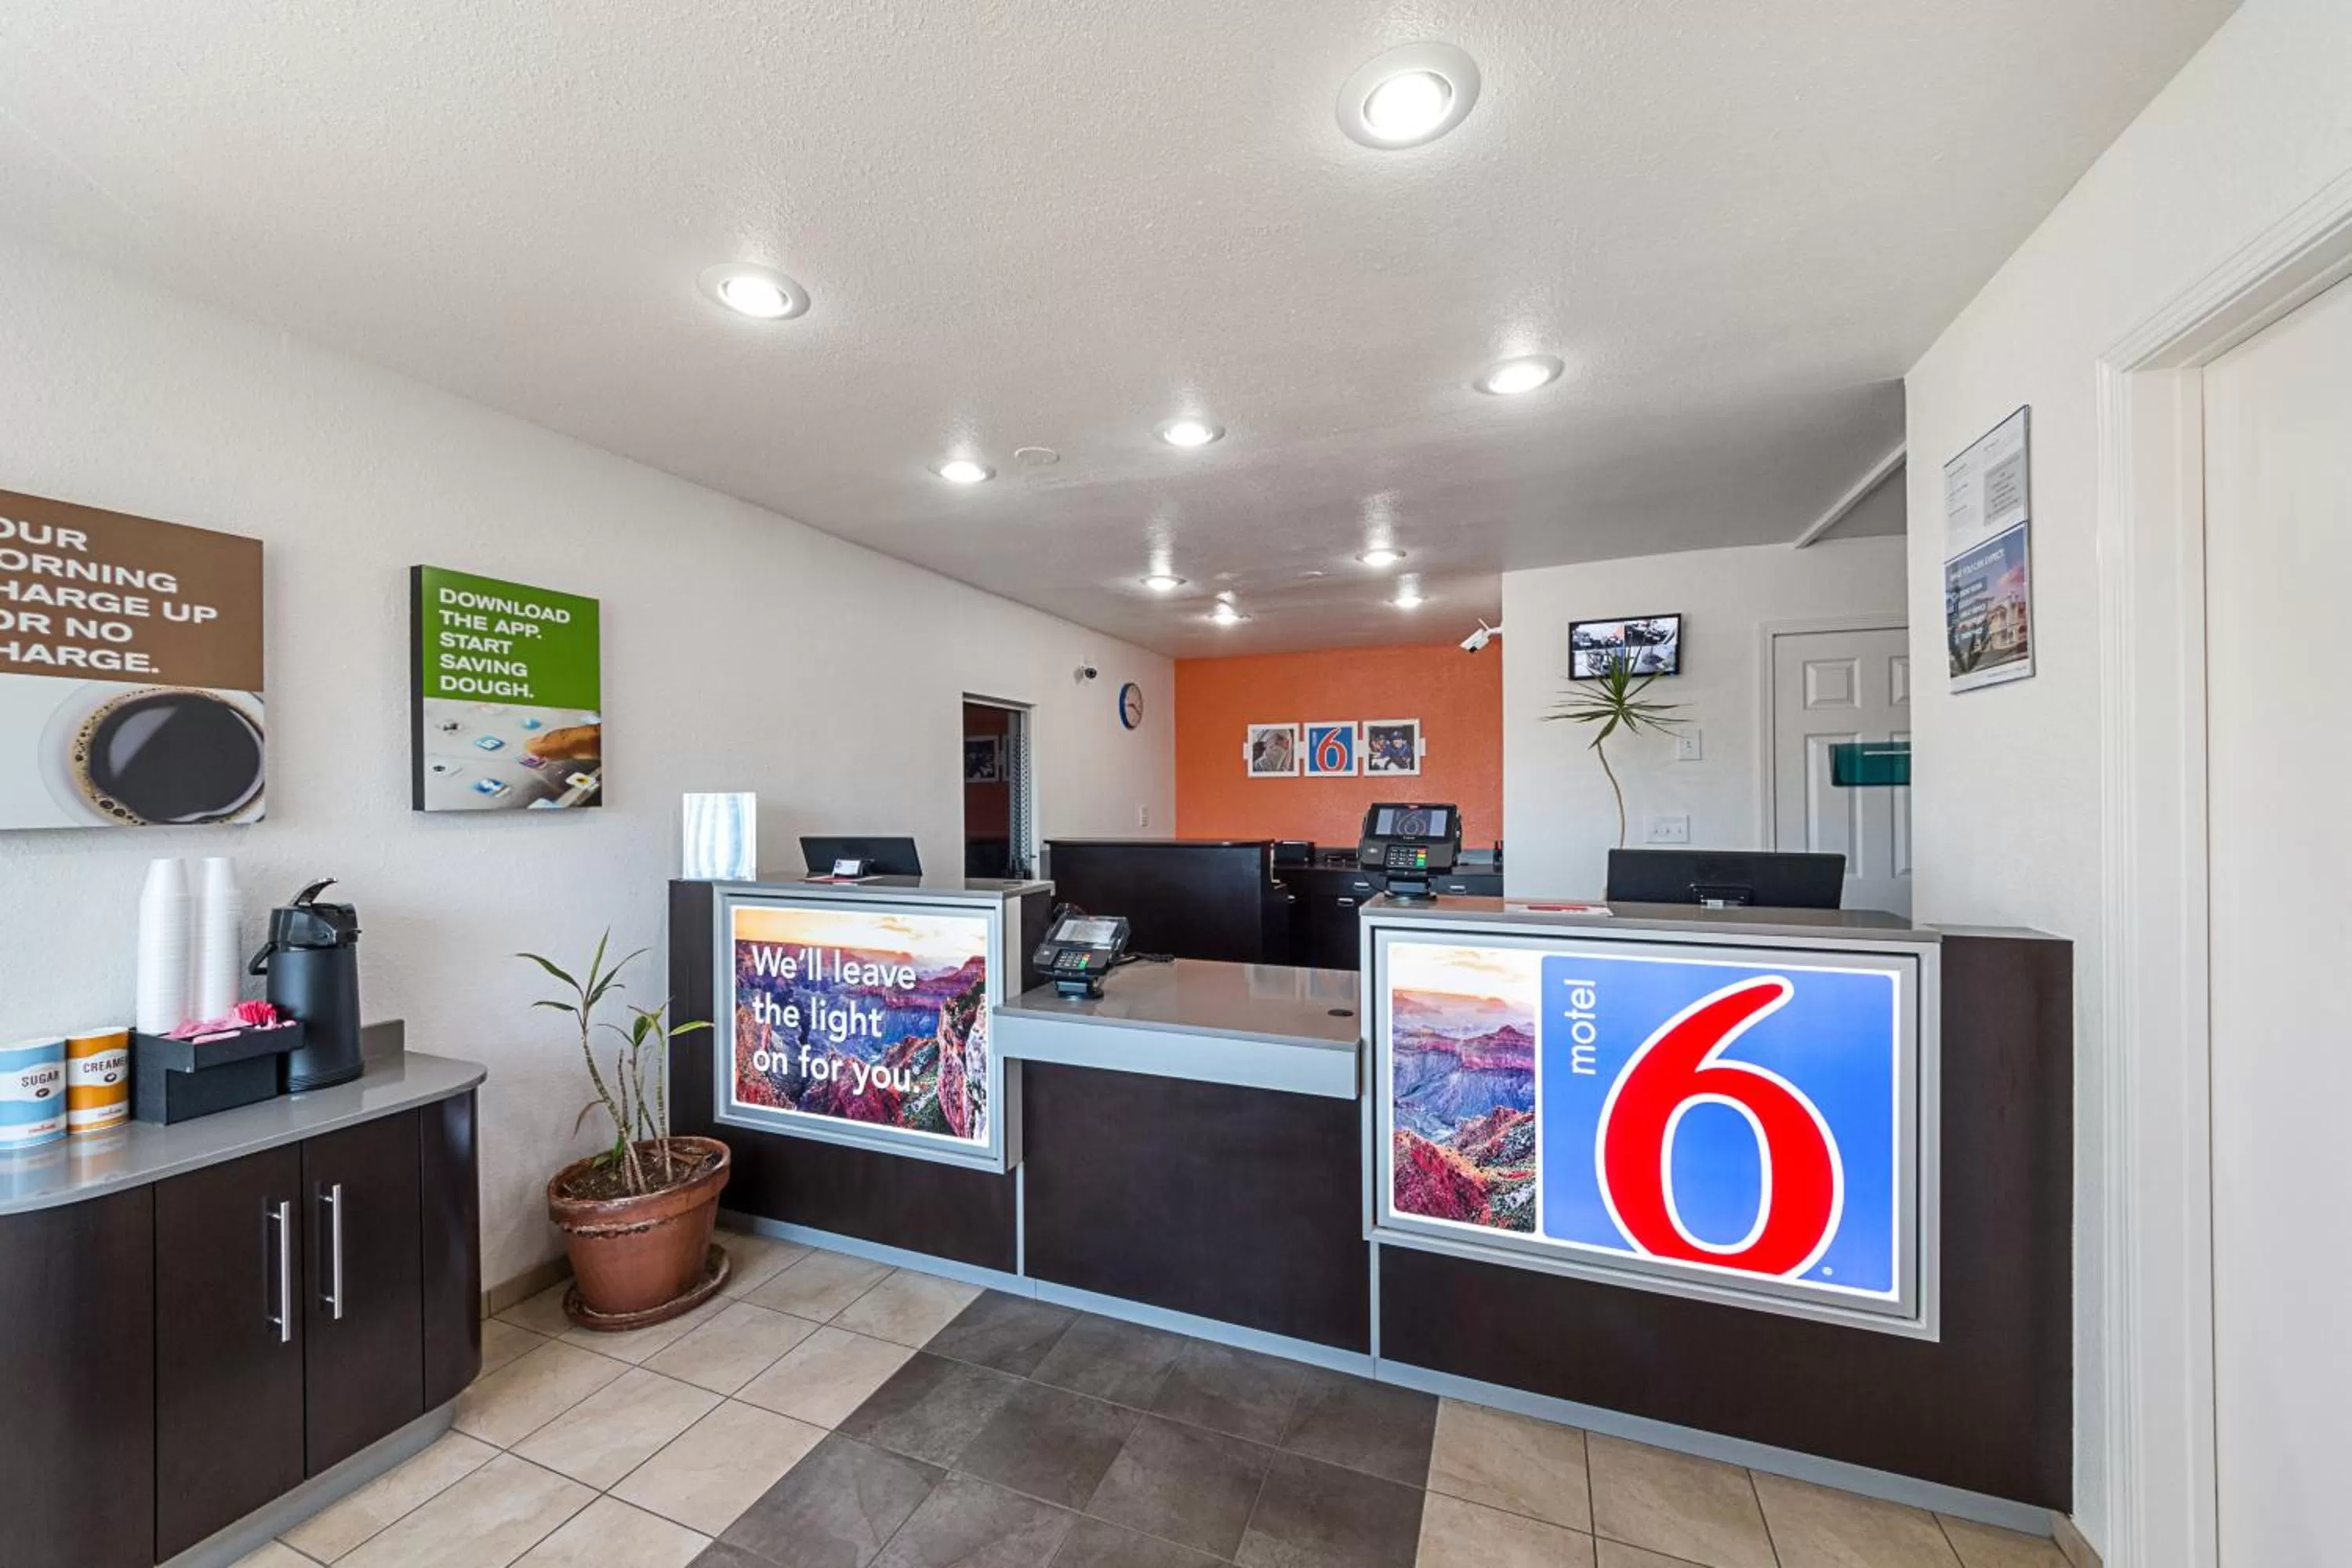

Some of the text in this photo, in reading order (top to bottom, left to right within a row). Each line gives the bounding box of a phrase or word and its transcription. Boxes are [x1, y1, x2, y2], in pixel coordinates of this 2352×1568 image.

[0, 548, 177, 593] ORNING
[162, 601, 217, 623] UP
[439, 587, 571, 624] DOWNLOAD
[439, 609, 542, 639] THE APP.
[66, 617, 132, 642] NO
[439, 631, 513, 655] START
[439, 653, 528, 677] SAVING
[439, 674, 535, 698] DOUGH.
[1316, 728, 1347, 772] 6
[834, 949, 916, 990] leave
[752, 992, 883, 1042] the light
[1563, 978, 1596, 1076] motel
[21, 1070, 60, 1088] SUGAR
[753, 1045, 920, 1095] on for you.
[1595, 975, 1844, 1280] 6
